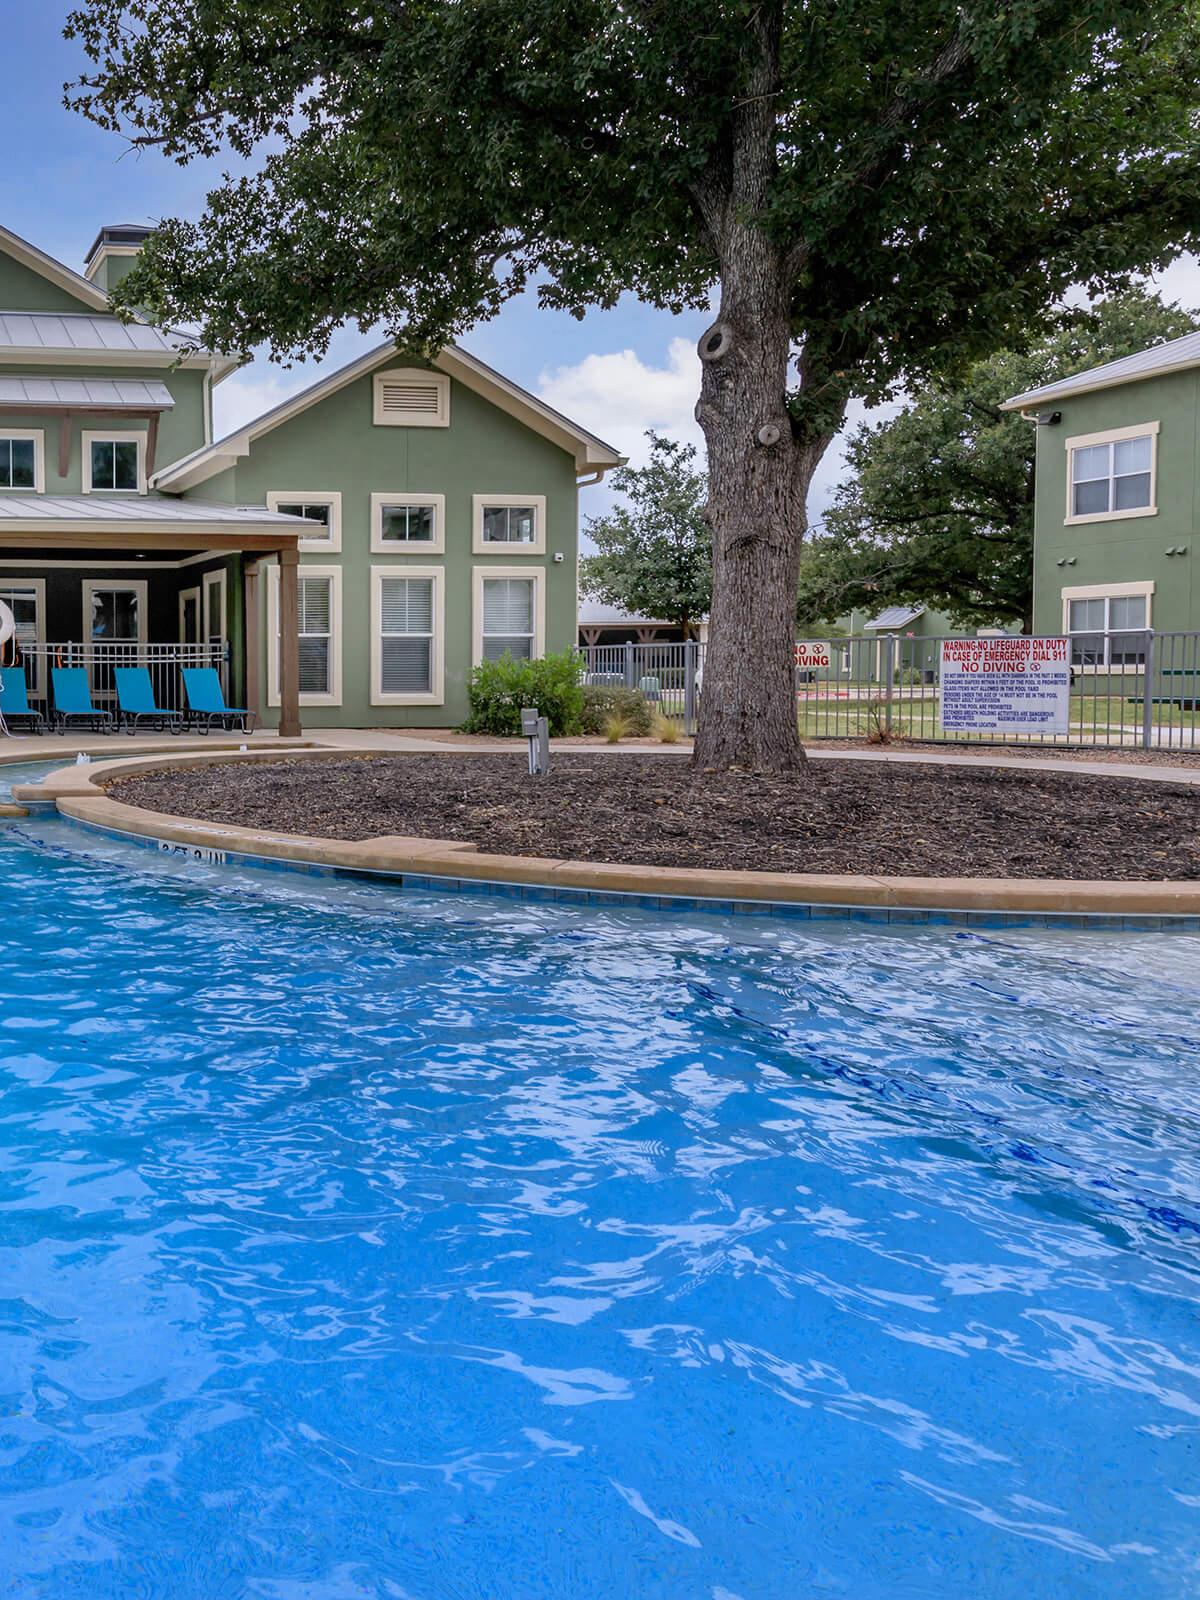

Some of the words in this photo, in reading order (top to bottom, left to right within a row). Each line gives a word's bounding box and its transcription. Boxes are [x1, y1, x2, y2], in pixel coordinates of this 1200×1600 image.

[990, 640, 1030, 650] LIFEGUARD
[1033, 640, 1044, 650] ON
[1046, 640, 1067, 649] DUTY
[944, 652, 951, 661] IN
[952, 652, 971, 661] CASE
[973, 651, 982, 661] OF
[984, 651, 1030, 661] EMERGENCY
[1033, 651, 1050, 660] DIAL
[1053, 650, 1067, 660] 911
[961, 662, 979, 672] NO
[983, 662, 1025, 672] DIVING
